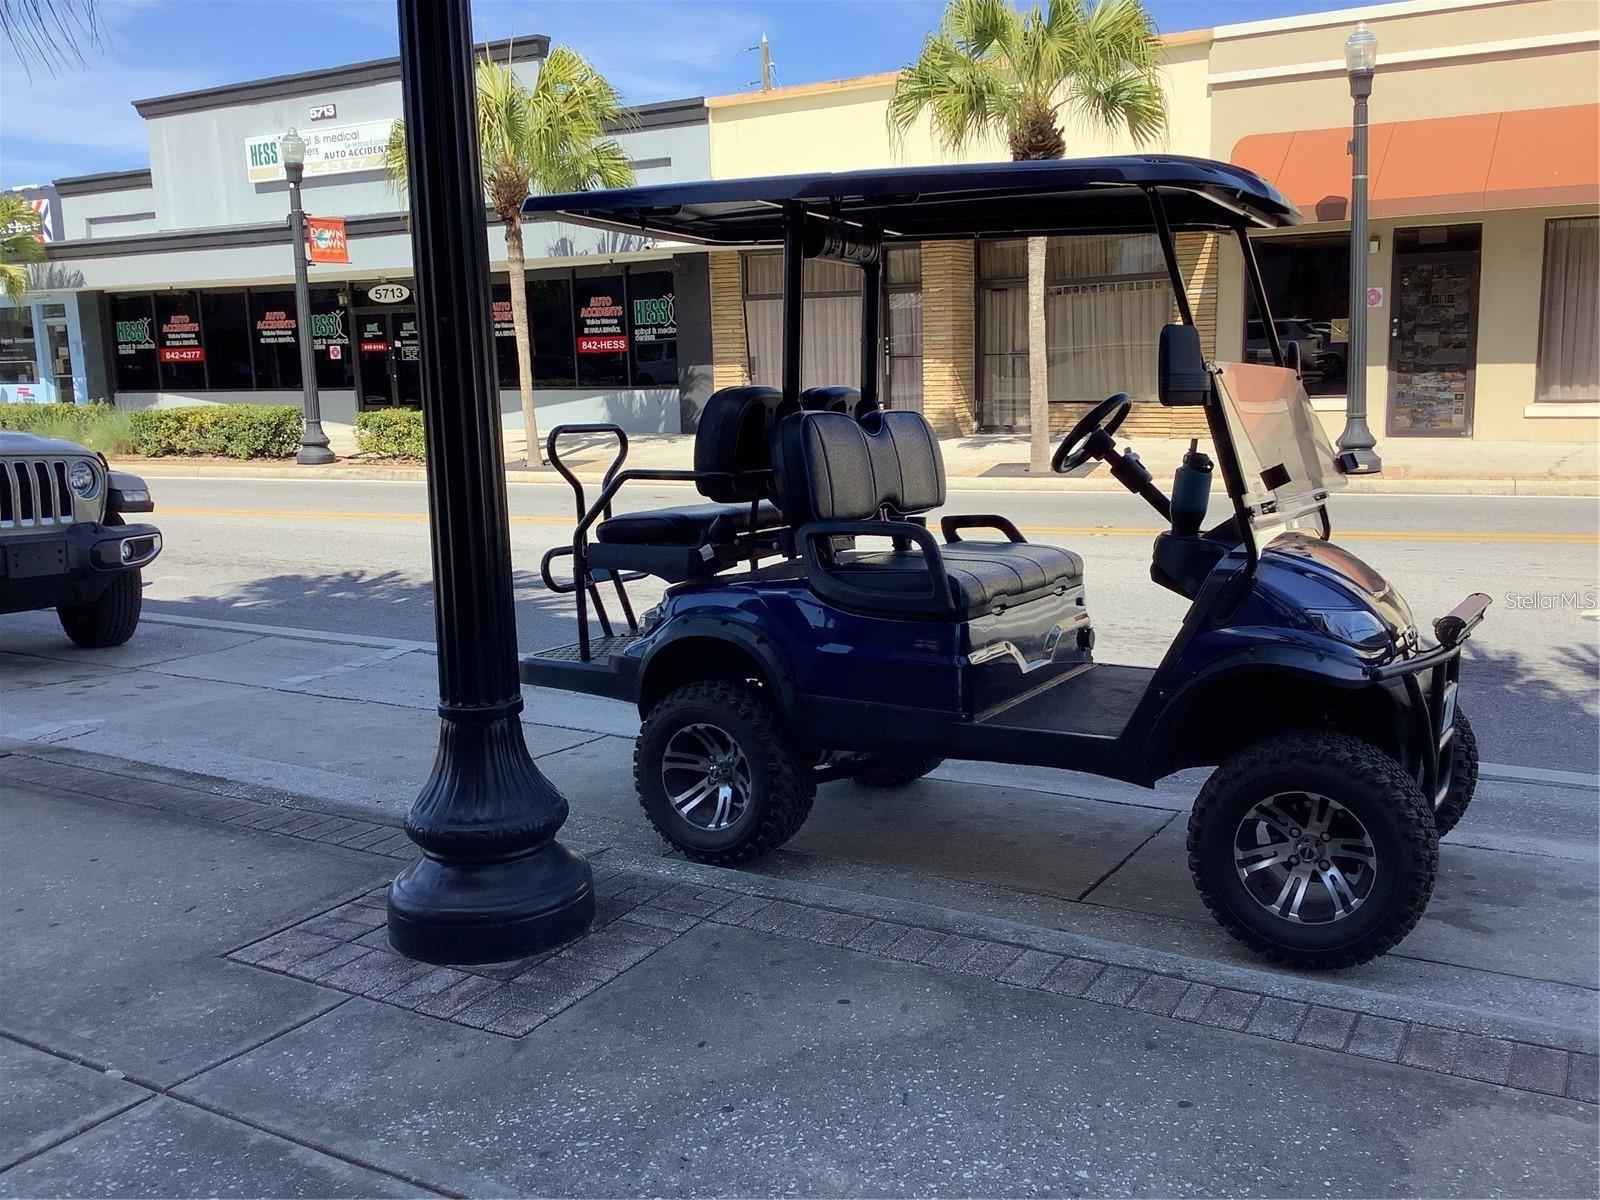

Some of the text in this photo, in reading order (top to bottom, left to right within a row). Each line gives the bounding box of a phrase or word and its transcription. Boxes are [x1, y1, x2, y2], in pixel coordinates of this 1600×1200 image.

[309, 105, 335, 119] 5713
[323, 130, 360, 143] medical
[250, 141, 278, 167] HESS
[324, 144, 389, 160] AUTO ACCIDENT
[310, 227, 344, 239] DOWN
[311, 237, 345, 248] TOWN
[374, 288, 404, 299] 5713
[589, 296, 612, 307] AUTO
[265, 311, 286, 320] AUTO
[580, 306, 623, 318] ACCIDENTS
[634, 299, 668, 325] HESS
[170, 314, 189, 323] AUTO
[116, 321, 144, 342] HESS
[582, 340, 625, 350] 842-HESS
[165, 350, 201, 360] 842-4377
